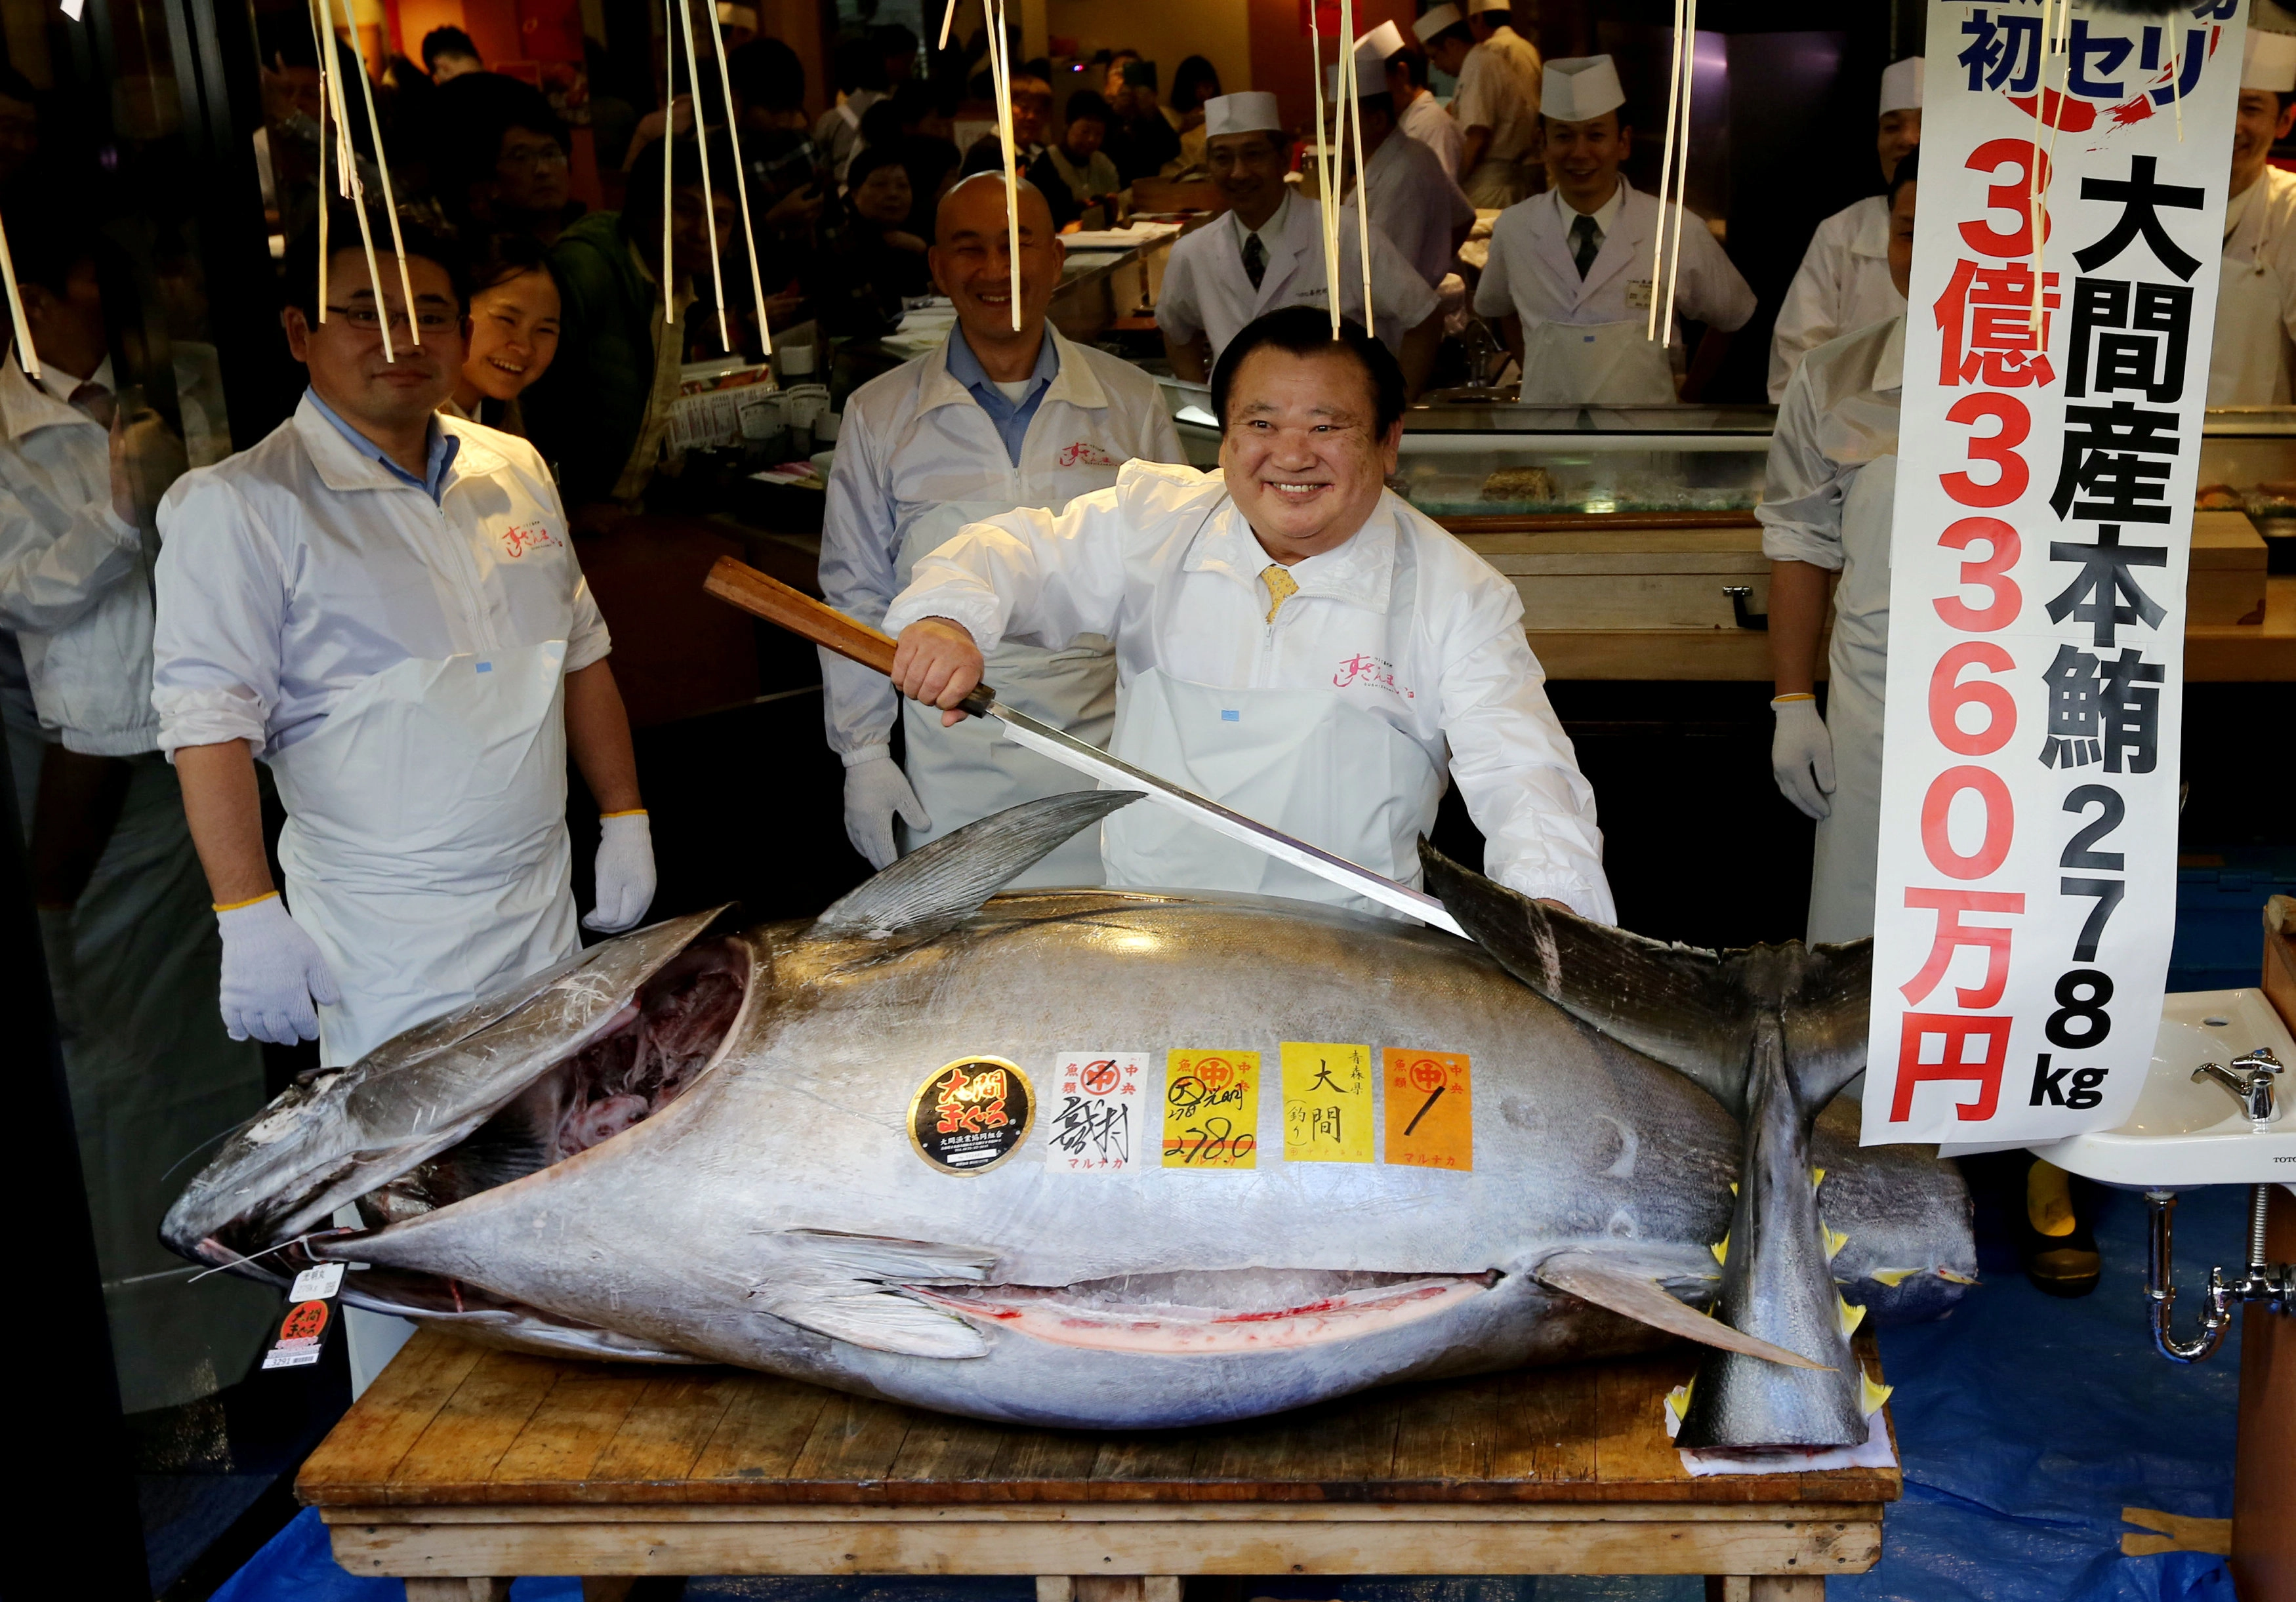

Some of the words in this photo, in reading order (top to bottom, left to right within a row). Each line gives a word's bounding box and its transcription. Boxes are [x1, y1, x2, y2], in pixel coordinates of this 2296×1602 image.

[1958, 9, 2206, 106] 初セリ
[937, 1068, 1008, 1103] 大間
[1349, 1050, 1364, 1096] 青森県
[935, 1099, 1009, 1134] まぐろ
[1305, 1058, 1349, 1143] 大間
[1404, 1153, 1456, 1166] マルナカ
[272, 1357, 291, 1366] 3291
